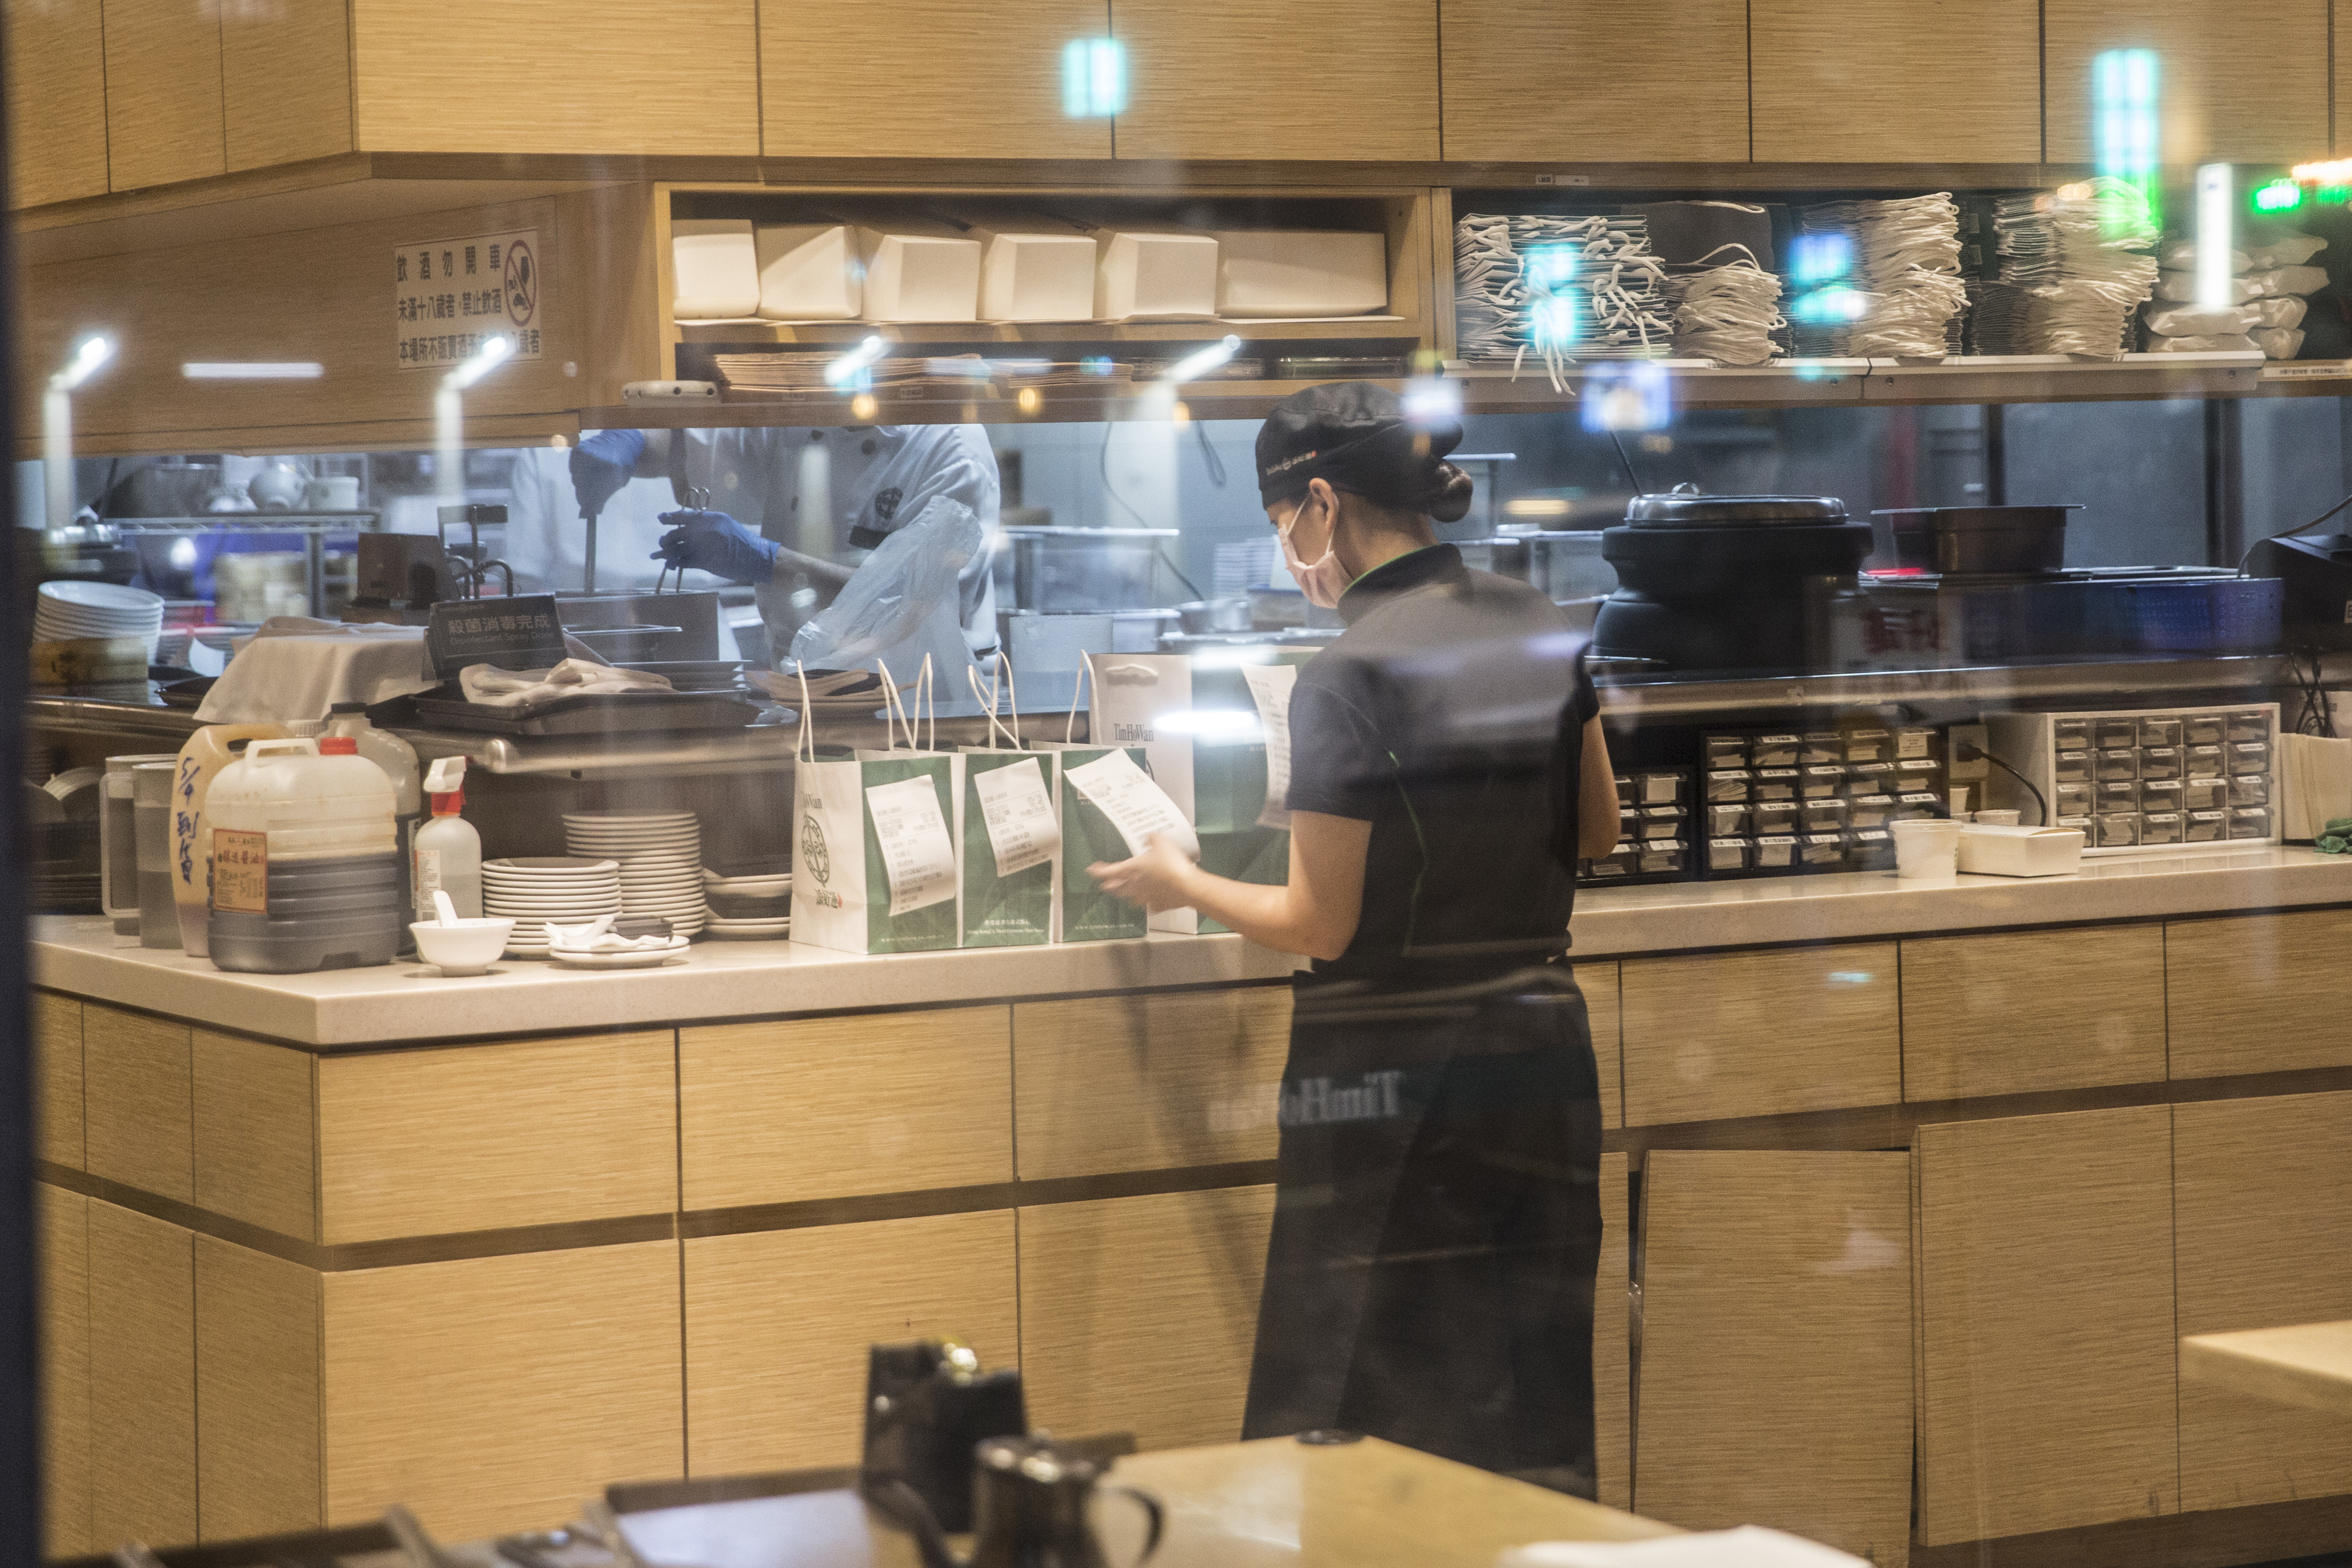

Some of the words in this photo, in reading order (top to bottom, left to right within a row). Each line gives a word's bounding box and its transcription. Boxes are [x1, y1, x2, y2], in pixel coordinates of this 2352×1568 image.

[448, 613, 551, 635] 殺菌消毒完成
[1114, 723, 1154, 742] TimHoWan
